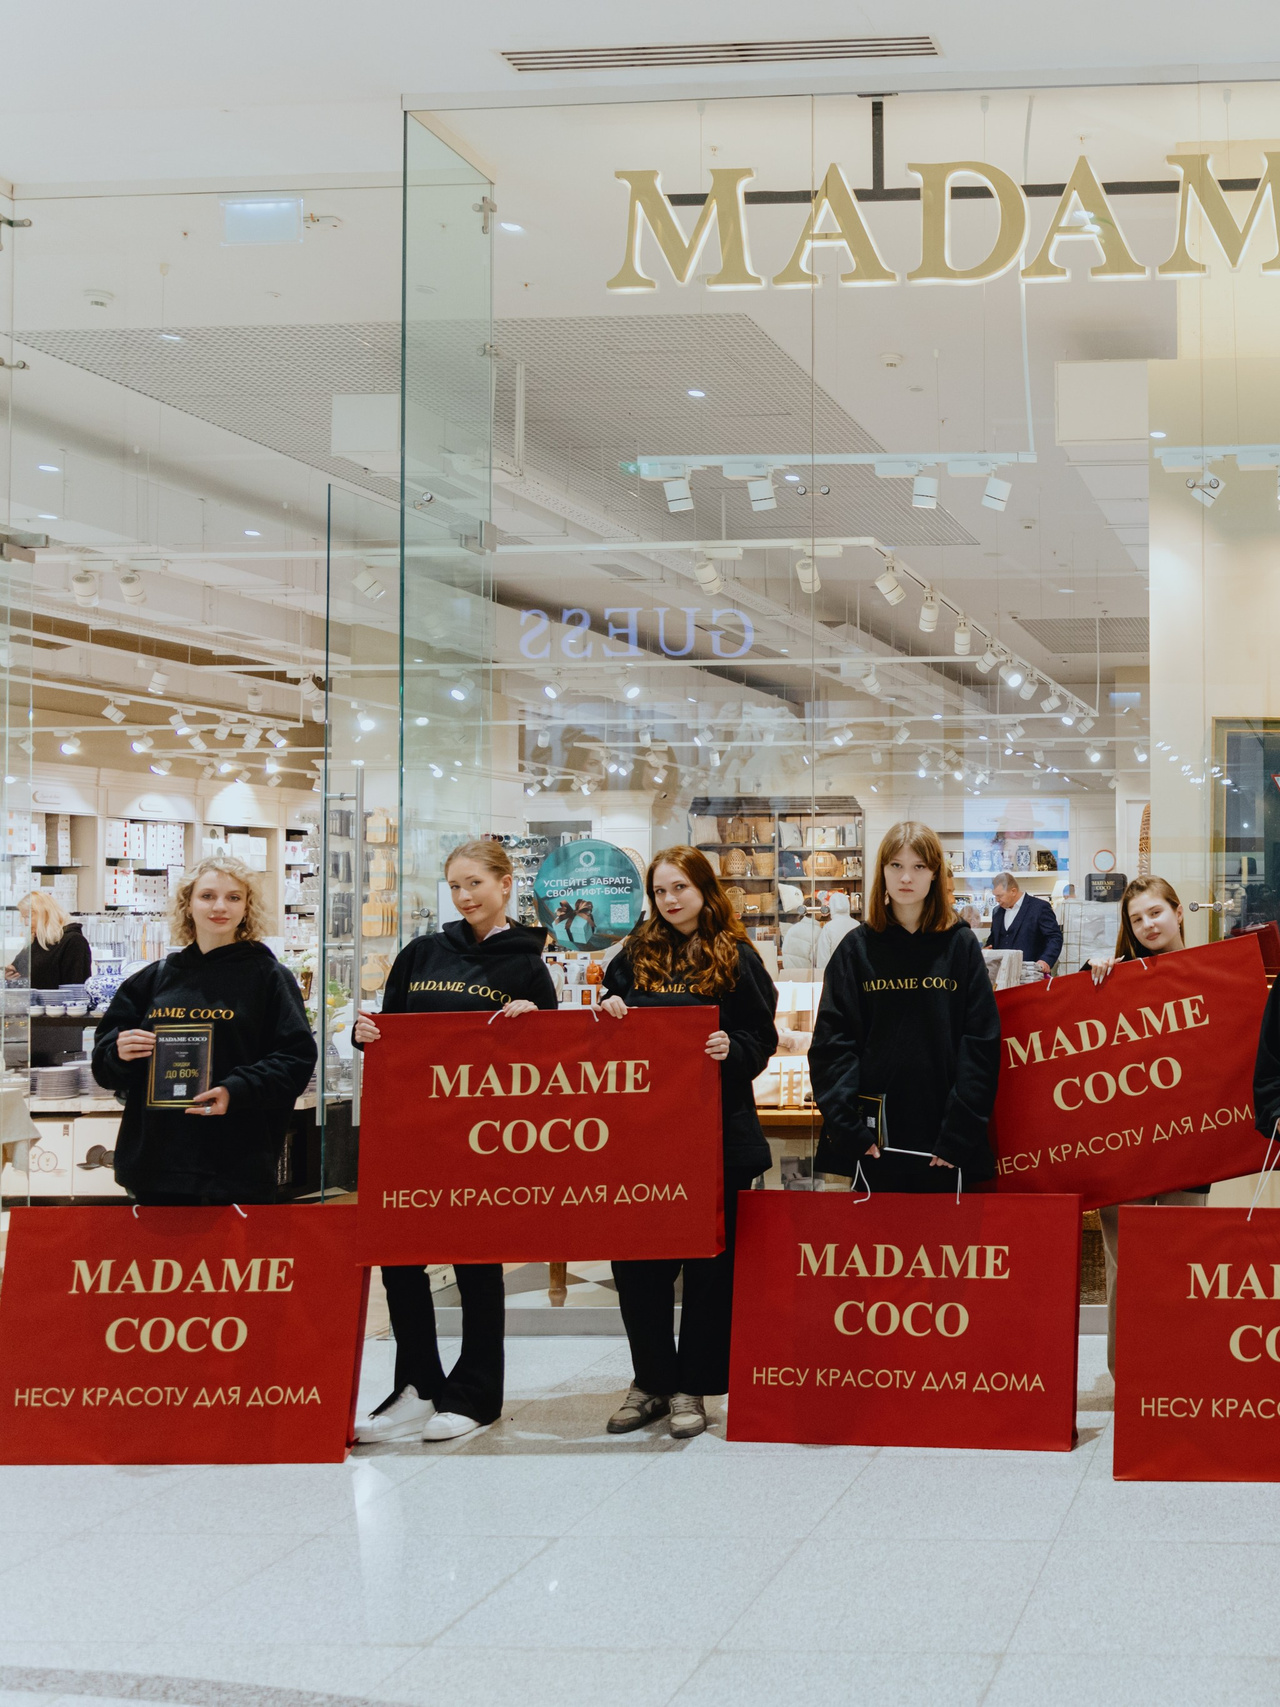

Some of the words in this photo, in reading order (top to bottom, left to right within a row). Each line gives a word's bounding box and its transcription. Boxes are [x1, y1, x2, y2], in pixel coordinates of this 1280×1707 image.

[544, 877, 587, 887] УСПЕЙТЕ
[590, 876, 633, 886] ЗАБРАТЬ
[546, 887, 573, 898] СВОЙ
[576, 886, 631, 896] ГИФТ-БОКС
[408, 980, 466, 993] MADAME
[468, 984, 512, 1005] COCO
[189, 1008, 235, 1020] COCO
[1004, 995, 1210, 1073] MADAME
[165, 1070, 177, 1079] ДО
[179, 1069, 199, 1078] 60%
[429, 1060, 650, 1098] MADAME
[1050, 1056, 1182, 1112] COCO
[469, 1118, 609, 1154] COCO
[1049, 1127, 1144, 1164] КРАСОТУ
[1152, 1117, 1194, 1144] ДЛЯ
[1200, 1104, 1254, 1133] ДОМ
[383, 1190, 443, 1208] НЕСУ
[451, 1187, 556, 1207] КРАСОТУ
[560, 1185, 607, 1207] ДЛЯ
[614, 1183, 688, 1205] ДОМА
[68, 1257, 295, 1295] MADAME
[797, 1243, 1011, 1280] MADAME
[834, 1301, 970, 1338] COCO
[106, 1316, 248, 1354] COCO
[753, 1367, 810, 1386] НЕСУ
[817, 1368, 917, 1389] КРАСОТУ
[921, 1371, 967, 1392] ДЛЯ
[973, 1372, 1046, 1392] ДОМА
[14, 1387, 76, 1407] НЕСУ
[82, 1386, 189, 1407] КРАСОТУ
[193, 1386, 241, 1408] ДЛЯ
[246, 1385, 322, 1408] ДОМА
[1141, 1397, 1204, 1418] НЕСУ
